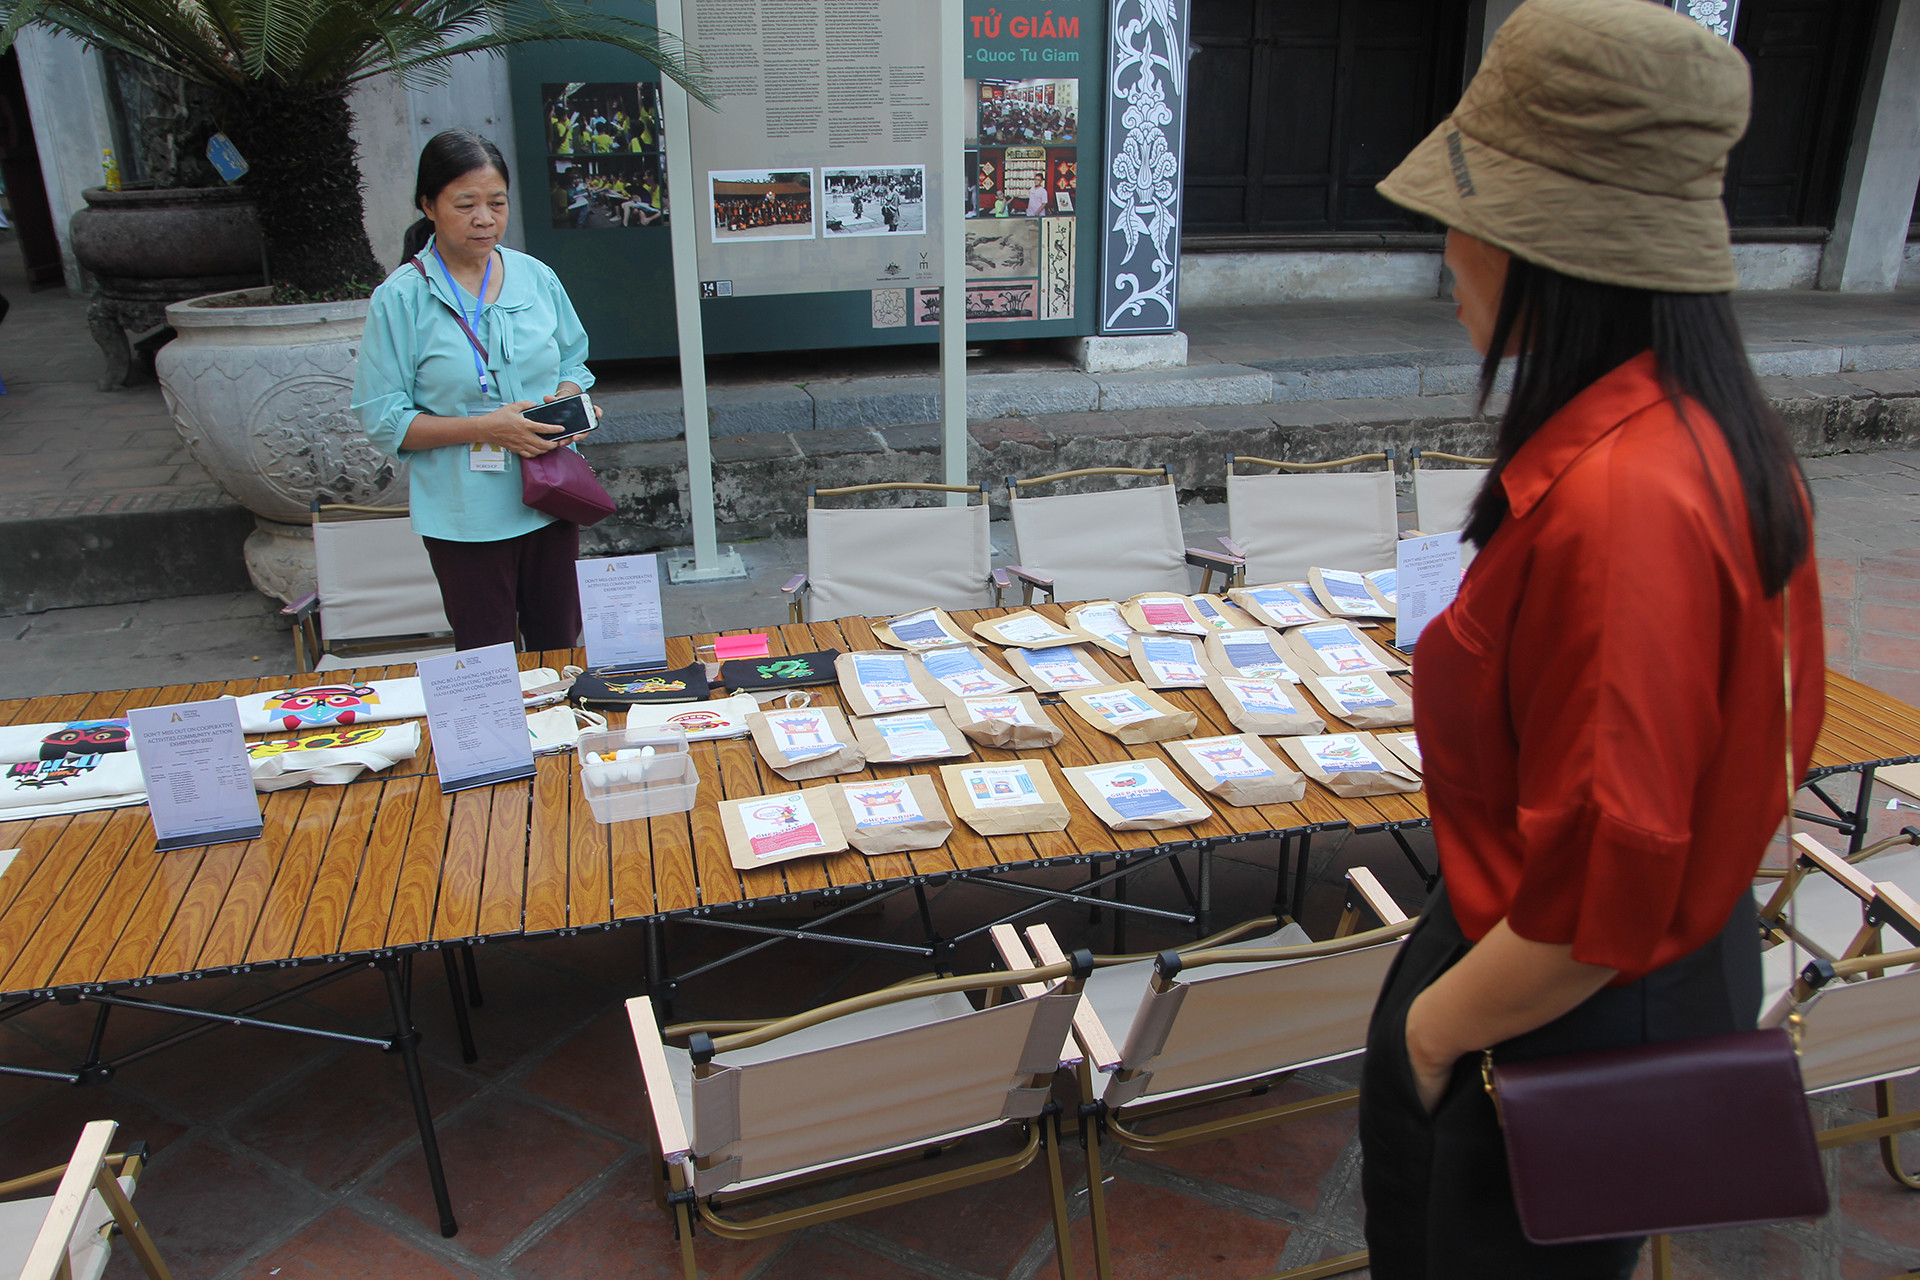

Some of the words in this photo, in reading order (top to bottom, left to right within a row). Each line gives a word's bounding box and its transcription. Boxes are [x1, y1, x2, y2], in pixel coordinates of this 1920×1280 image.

[970, 8, 1002, 38] TỬ
[1009, 10, 1079, 38] GIÁM
[976, 48, 1015, 62] Quoc
[1020, 49, 1037, 61] Tu
[1042, 48, 1079, 61] Giam
[702, 283, 714, 291] 14
[197, 722, 234, 731] COOPERATIVE
[177, 732, 210, 740] COMMUNITY
